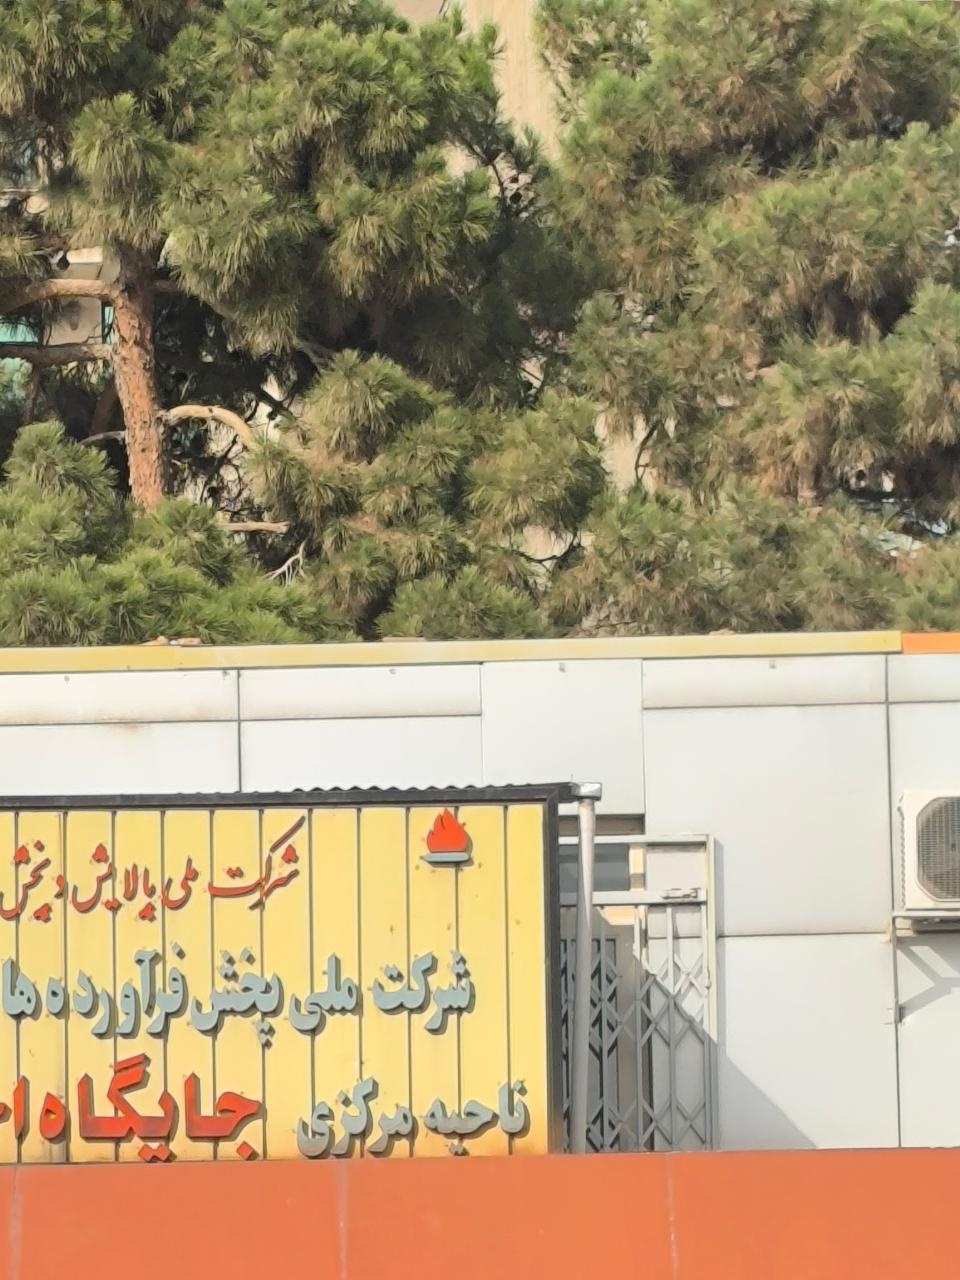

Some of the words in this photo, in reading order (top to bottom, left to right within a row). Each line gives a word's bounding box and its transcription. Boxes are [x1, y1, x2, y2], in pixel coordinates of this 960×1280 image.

[71, 843, 156, 922] پالایش
[161, 856, 200, 910] ملی
[207, 816, 306, 911] شرکت
[190, 947, 285, 1049] پخش
[290, 952, 363, 1036] ملی
[373, 950, 476, 1035] شرکت
[39, 1053, 268, 1163] جایگاه
[297, 1076, 418, 1159] مرکزی
[423, 1079, 530, 1156] ناحیه
